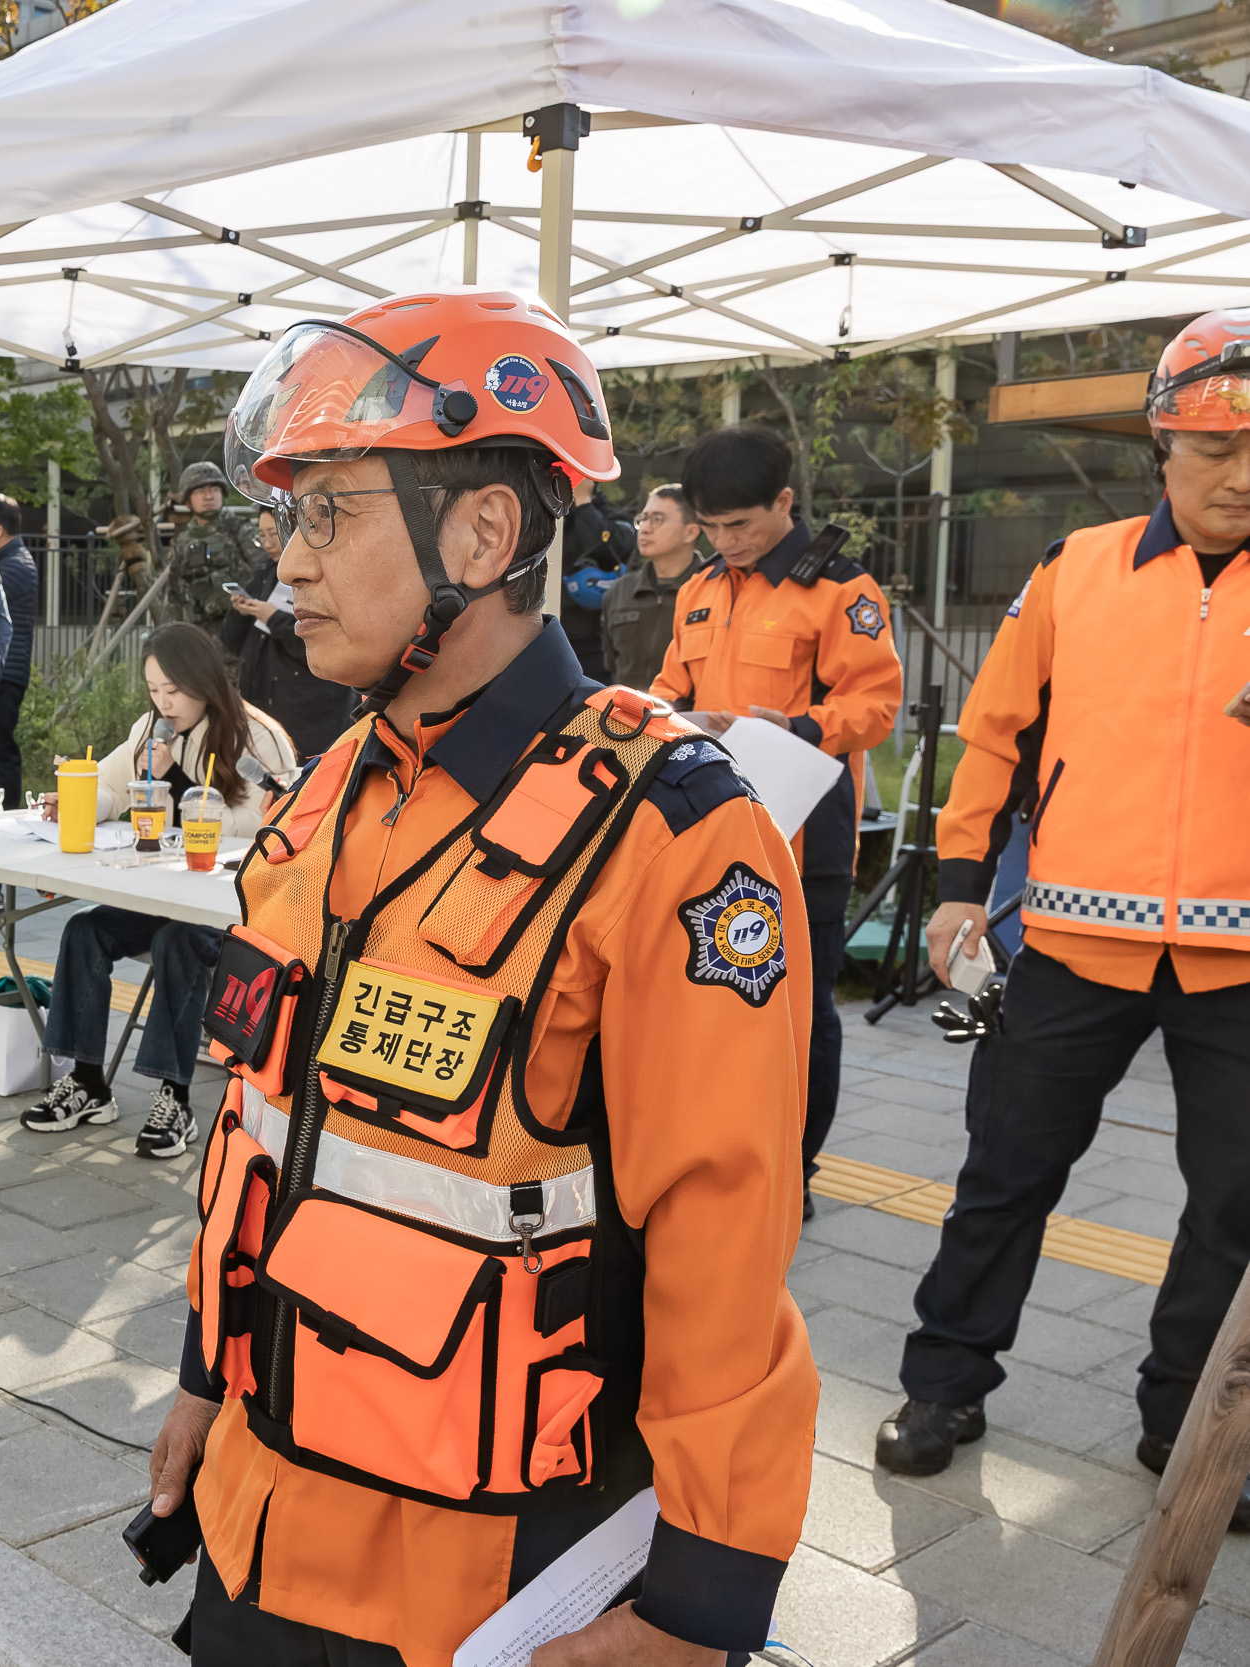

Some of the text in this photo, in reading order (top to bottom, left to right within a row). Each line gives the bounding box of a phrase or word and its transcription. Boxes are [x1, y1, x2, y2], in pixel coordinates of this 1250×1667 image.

[498, 374, 549, 402] 119
[505, 398, 528, 409] 서울소방
[717, 900, 776, 933] 대한민국소방
[732, 920, 765, 945] 119
[719, 935, 778, 965] KOREA FIRE SERVICE
[214, 967, 276, 1038] 119
[353, 981, 477, 1042] 긴급구조
[339, 1019, 465, 1081] 통제단장
